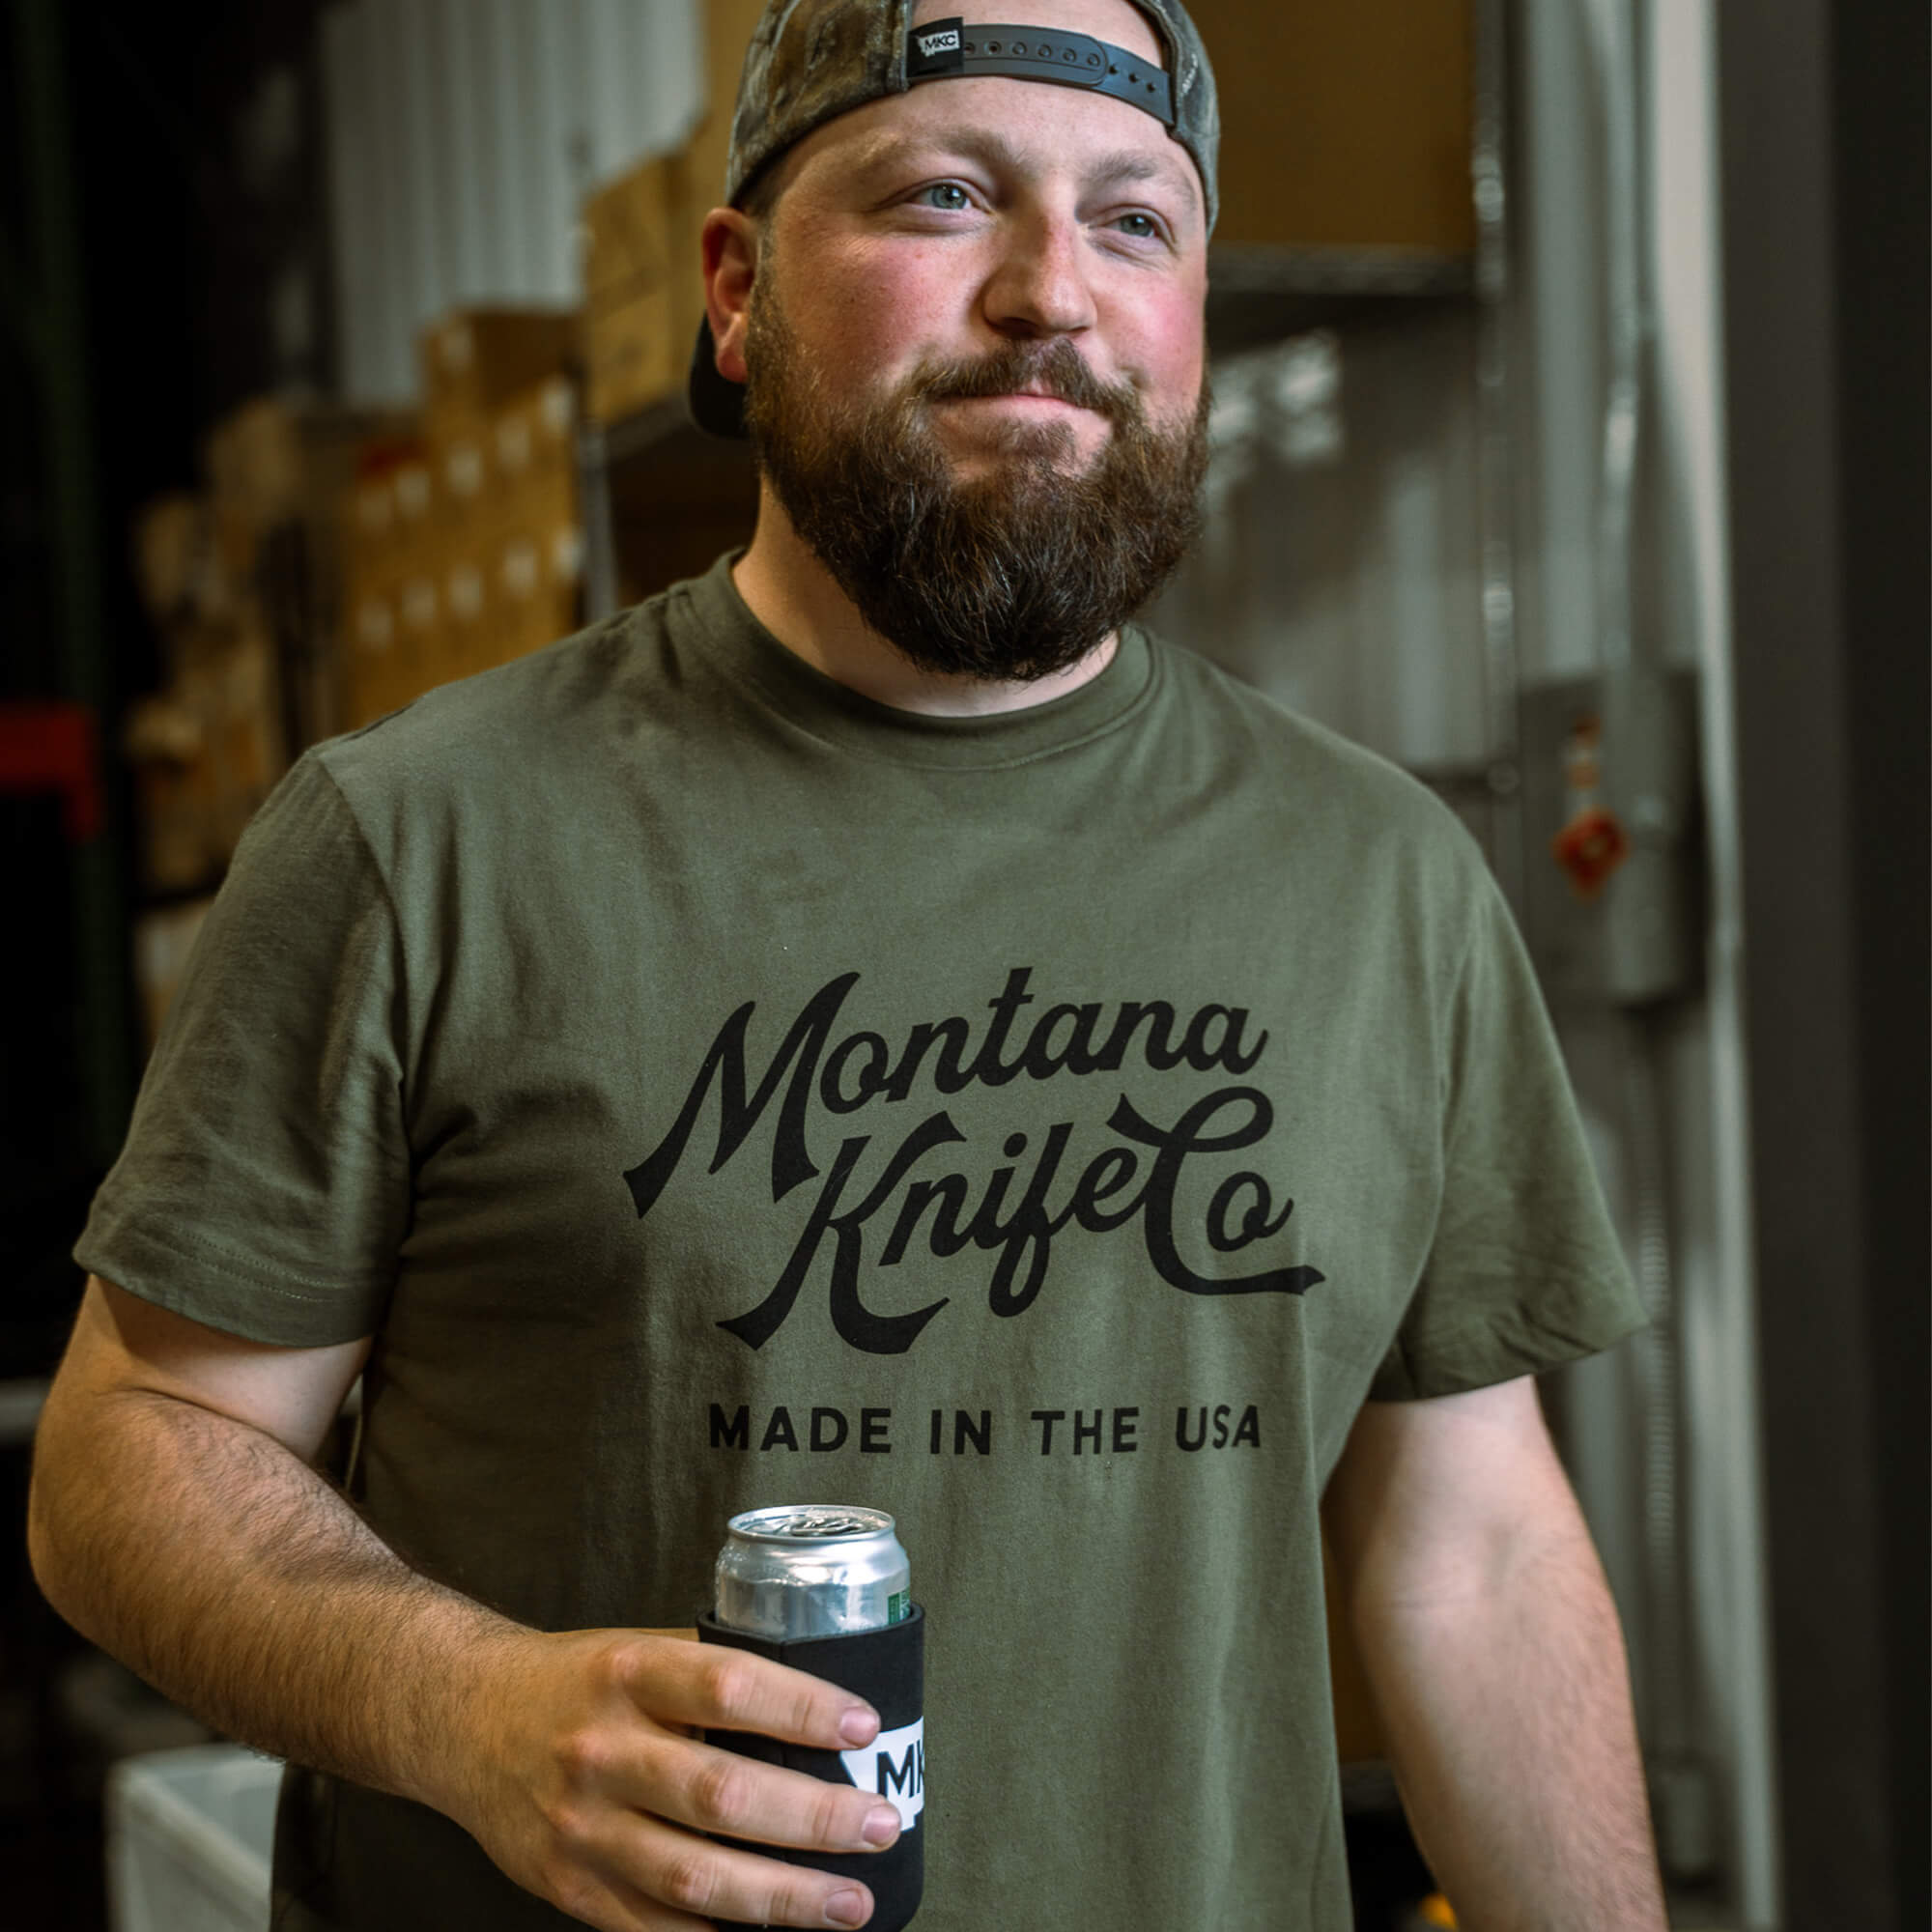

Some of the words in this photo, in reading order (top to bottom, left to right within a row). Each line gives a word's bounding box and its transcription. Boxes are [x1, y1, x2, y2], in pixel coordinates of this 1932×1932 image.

[924, 34, 957, 49] MKC
[622, 967, 1268, 1219] Montana
[716, 1111, 1149, 1353] Knife
[1107, 1086, 1326, 1295] Co
[709, 1403, 892, 1454] MADE
[930, 1409, 992, 1455] IN
[1031, 1406, 1141, 1455] THE
[1175, 1405, 1262, 1451] USA
